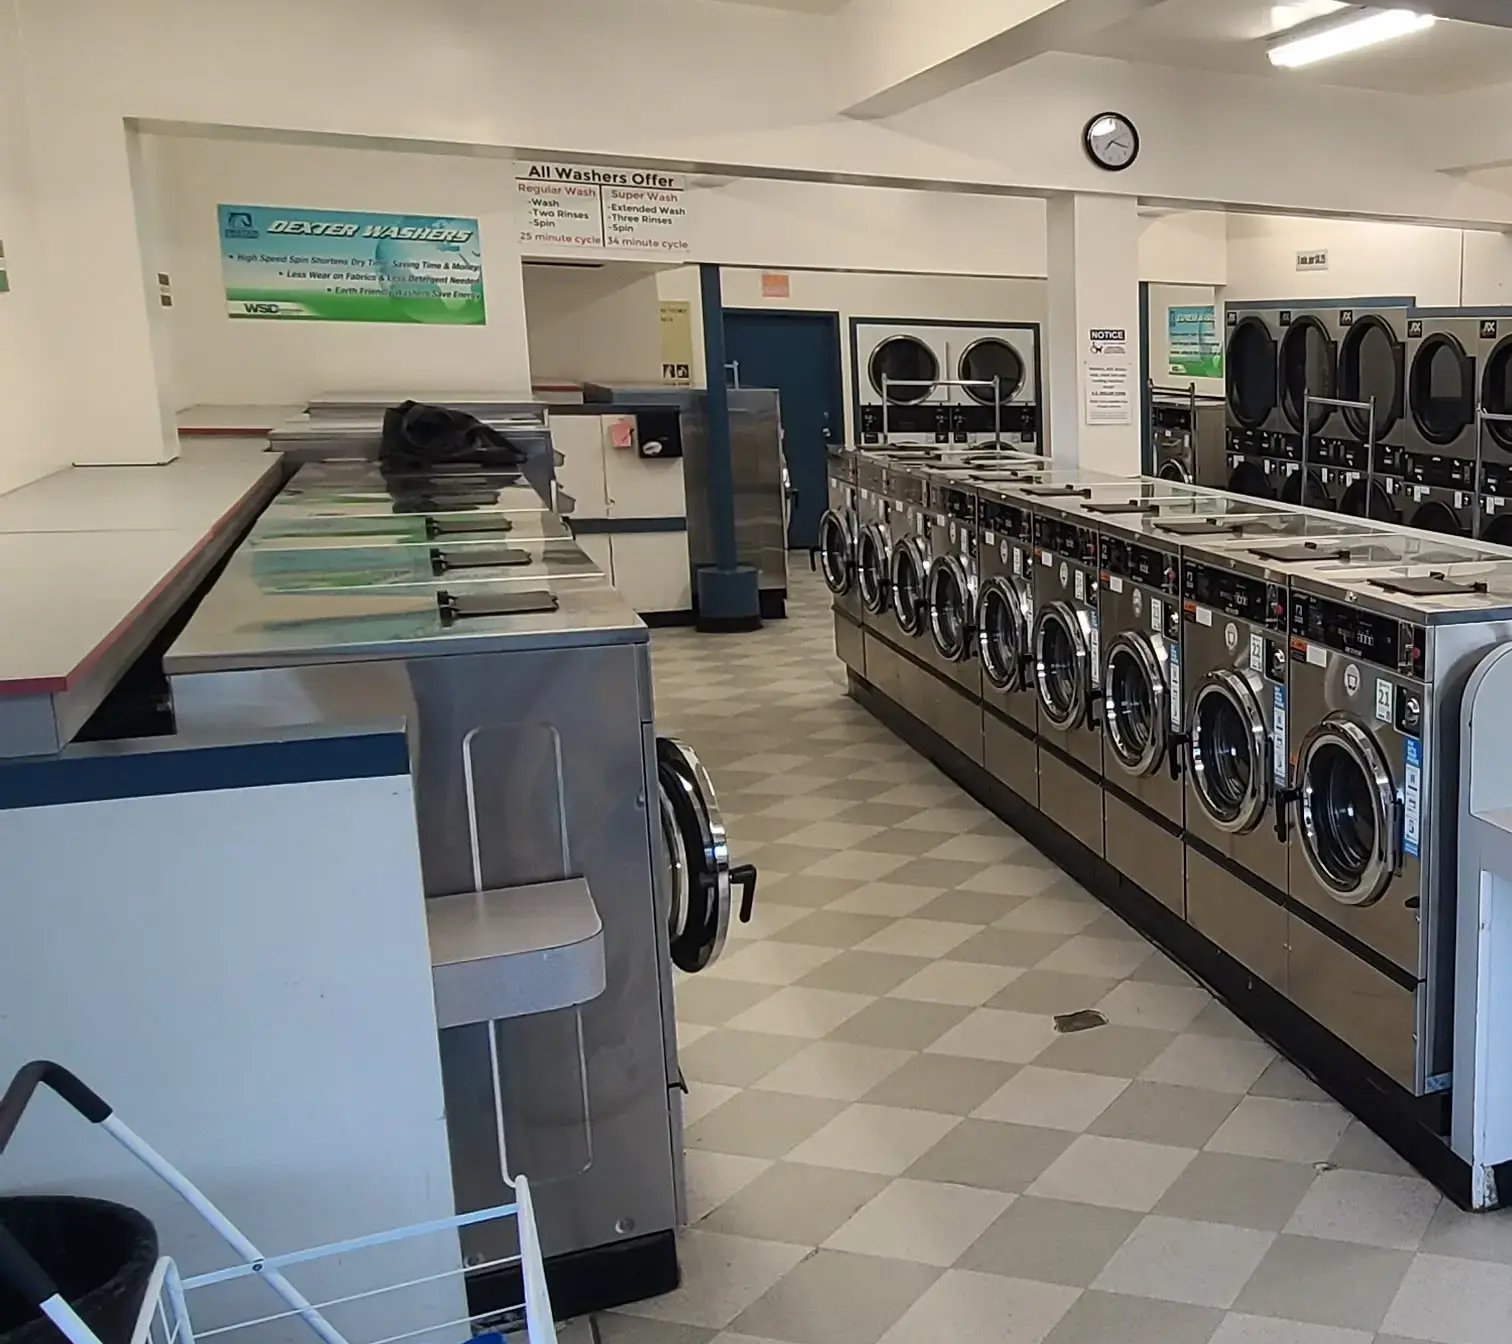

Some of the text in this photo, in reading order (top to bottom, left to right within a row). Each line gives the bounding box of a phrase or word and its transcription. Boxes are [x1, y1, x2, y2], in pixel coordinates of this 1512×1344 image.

[528, 165, 674, 188] All Washers Offer
[518, 183, 596, 198] Regular Wash
[611, 189, 678, 203] Super Wash
[557, 210, 589, 220] Rinses
[659, 207, 686, 216] Wash
[641, 215, 672, 225] Rinses
[267, 219, 360, 238] DEXTER
[362, 223, 474, 244] WASHERS
[519, 232, 601, 246] 25 minute cycle
[607, 236, 688, 249] 34 minute cycle
[259, 254, 287, 264] Speed
[289, 255, 309, 264] Spin
[351, 258, 365, 267] Dry
[422, 261, 442, 270] Time
[443, 262, 450, 270] &
[286, 269, 306, 279] Less
[309, 271, 331, 280] Wear
[333, 272, 344, 280] on
[345, 272, 376, 282] Fabrics
[335, 286, 358, 295] Earth
[1091, 331, 1124, 339] NOTICE
[1252, 642, 1261, 658] 22
[1378, 688, 1390, 707] 21
